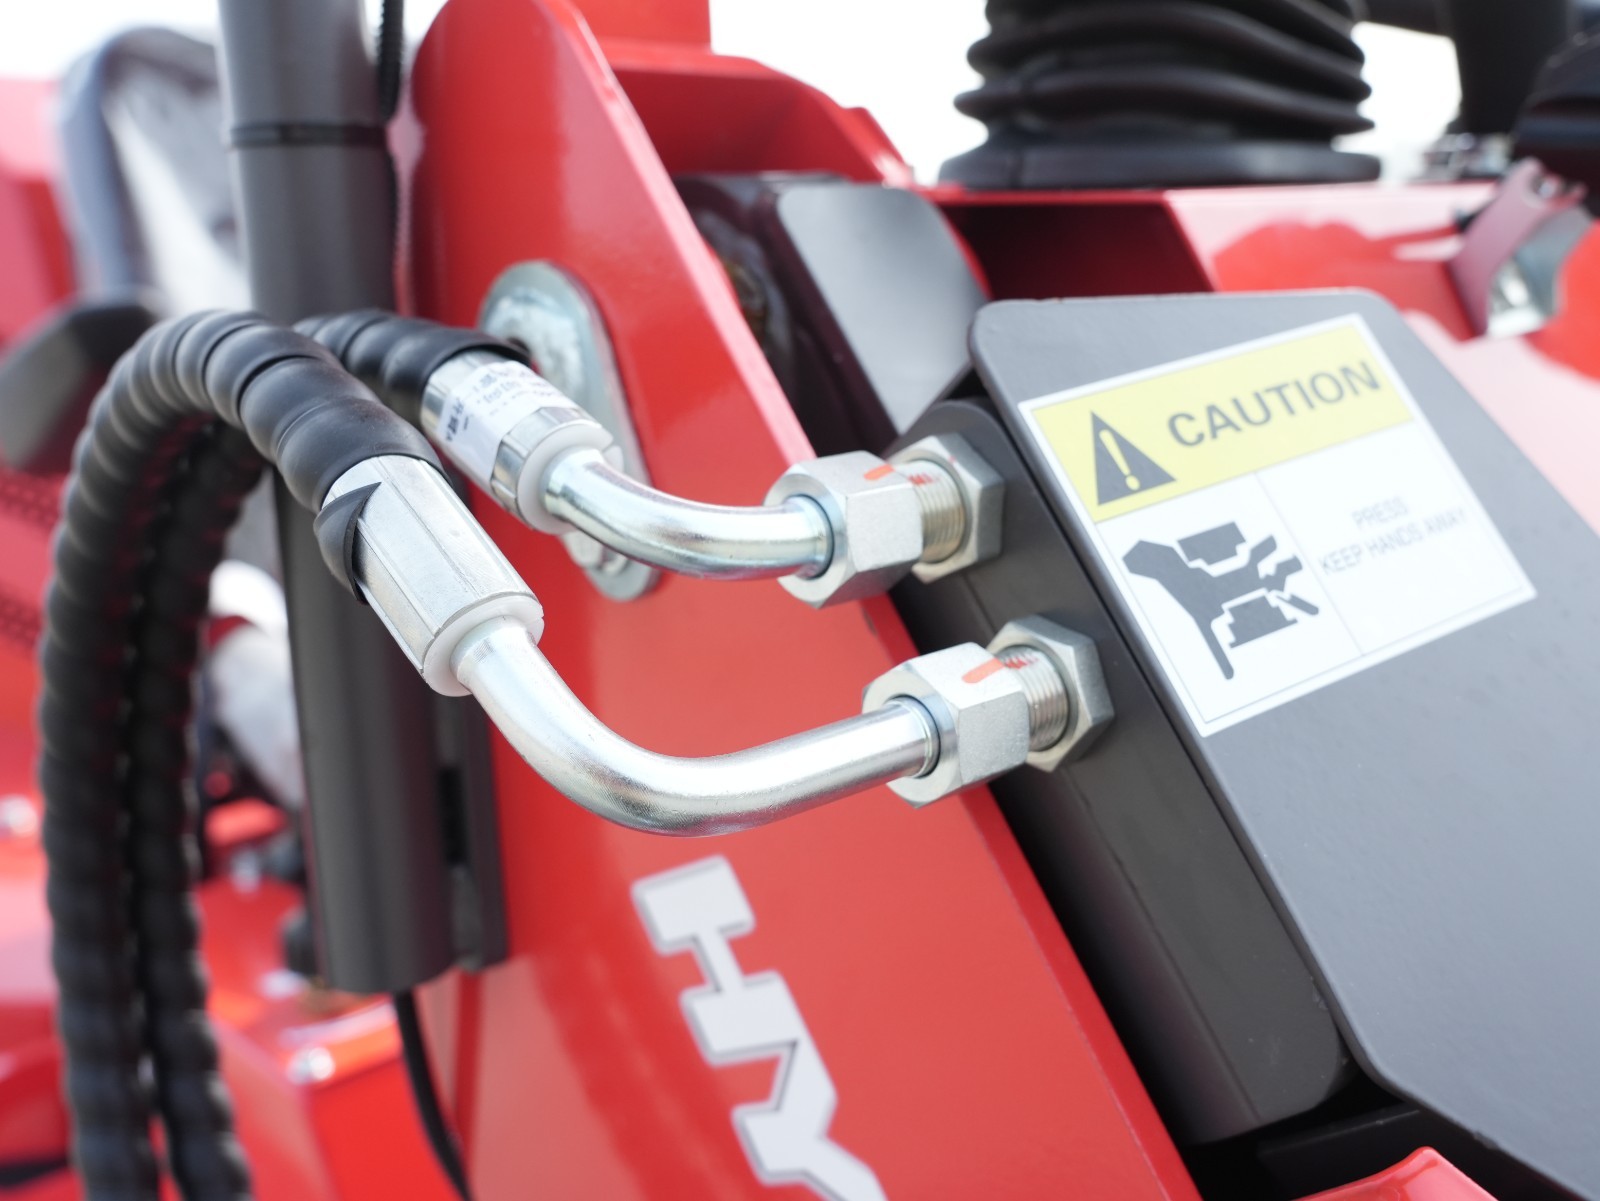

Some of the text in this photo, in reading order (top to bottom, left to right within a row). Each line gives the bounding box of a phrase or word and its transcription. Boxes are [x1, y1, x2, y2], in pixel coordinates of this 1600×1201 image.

[1167, 360, 1381, 447] CAUTION
[1318, 507, 1467, 575] KEEP HANDS AWAY
[1351, 495, 1409, 529] PRESS
